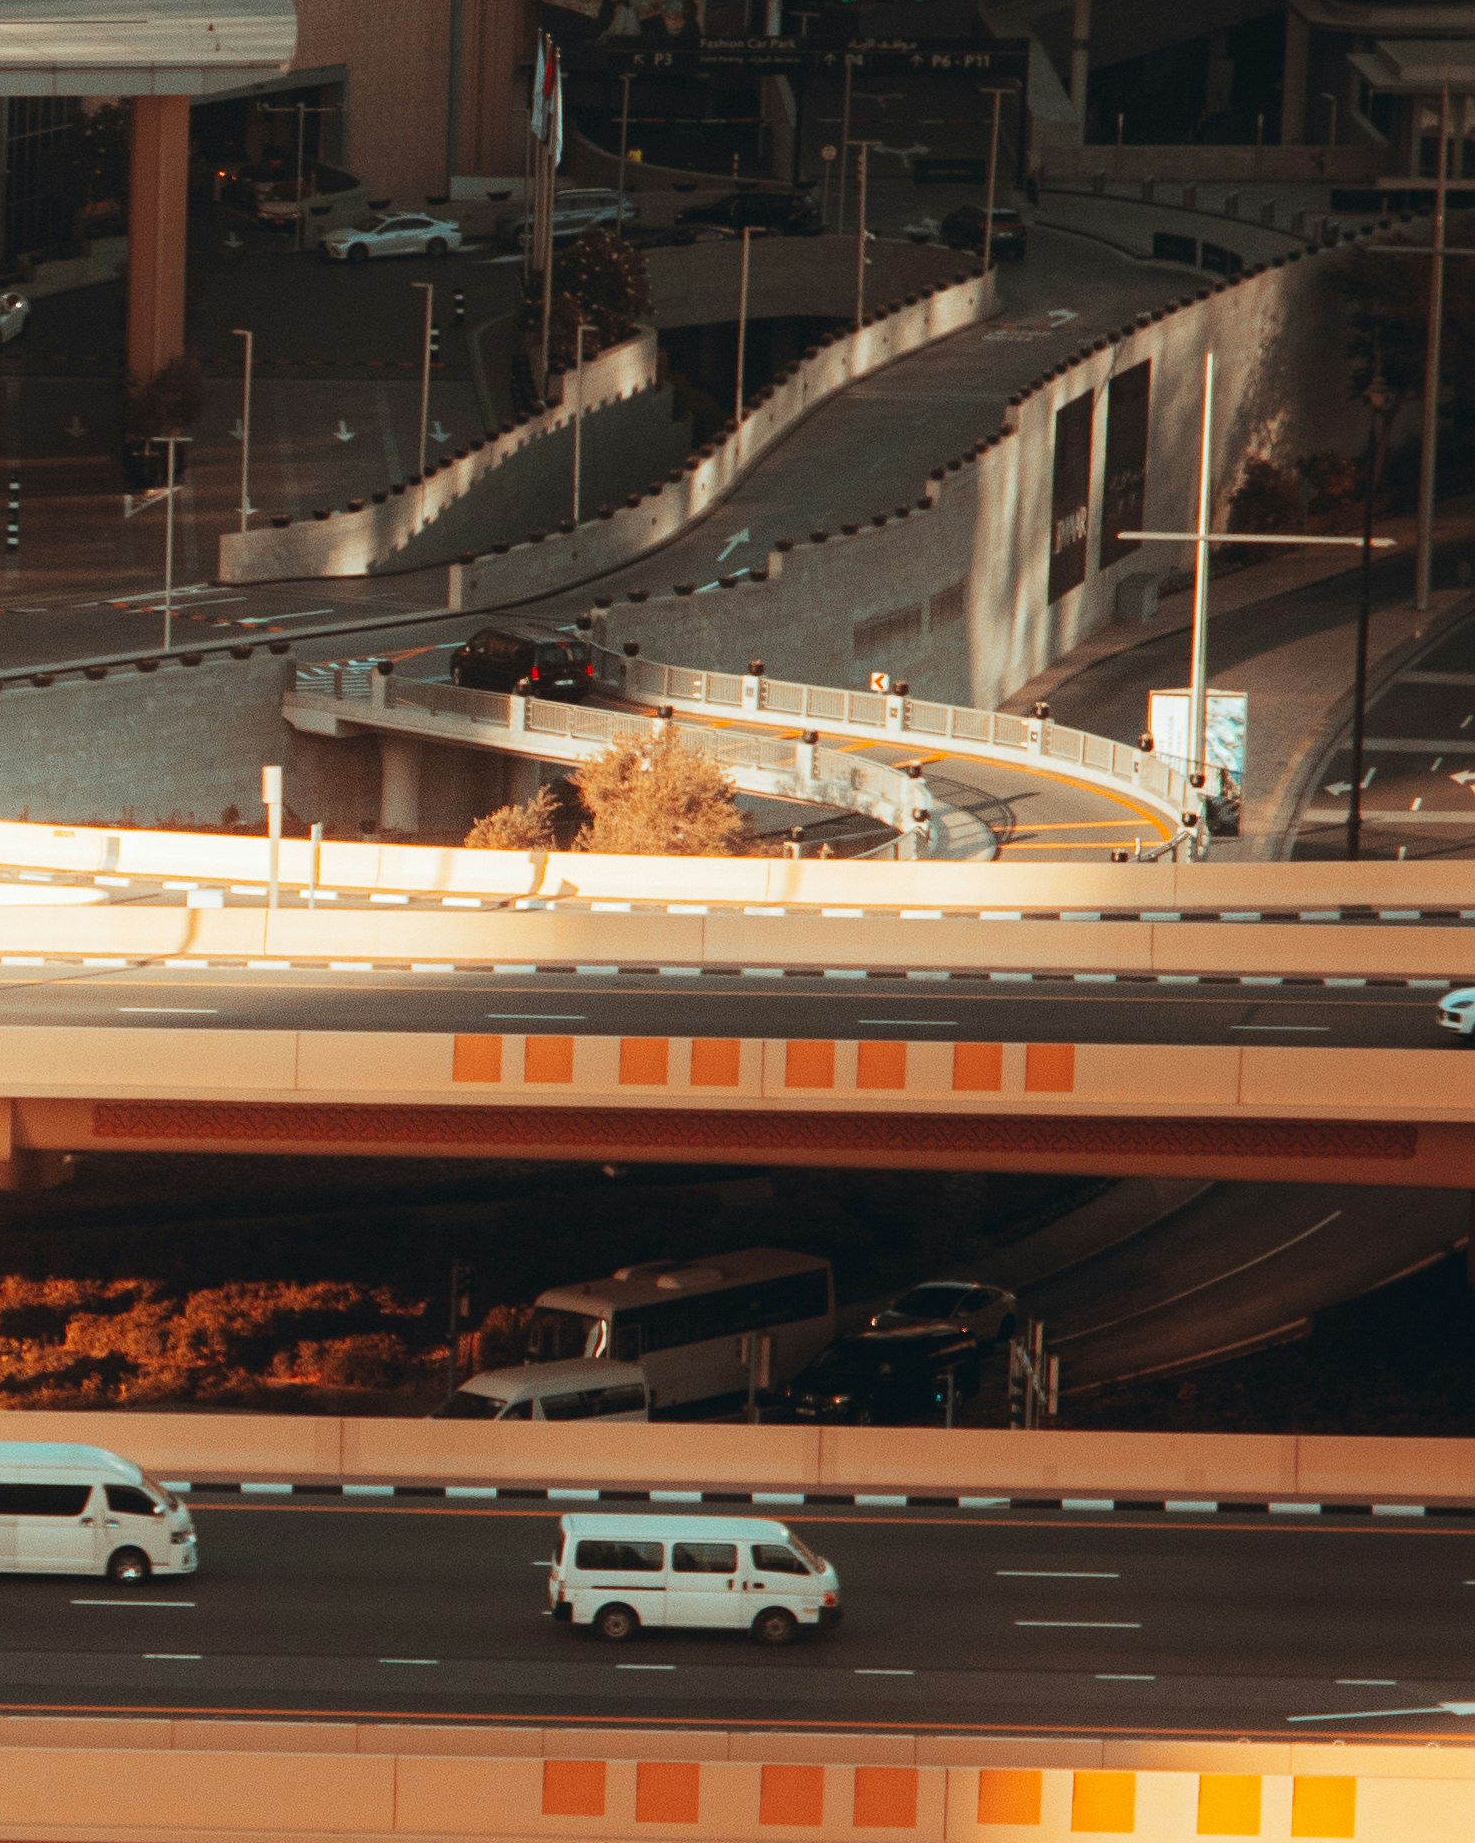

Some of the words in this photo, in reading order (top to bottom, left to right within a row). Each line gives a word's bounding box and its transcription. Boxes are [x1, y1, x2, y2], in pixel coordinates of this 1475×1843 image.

[699, 37, 745, 49] Fashion
[747, 37, 768, 49] Car
[769, 37, 797, 49] Park
[653, 52, 674, 66] P3
[931, 54, 952, 68] P6
[964, 53, 991, 68] P11
